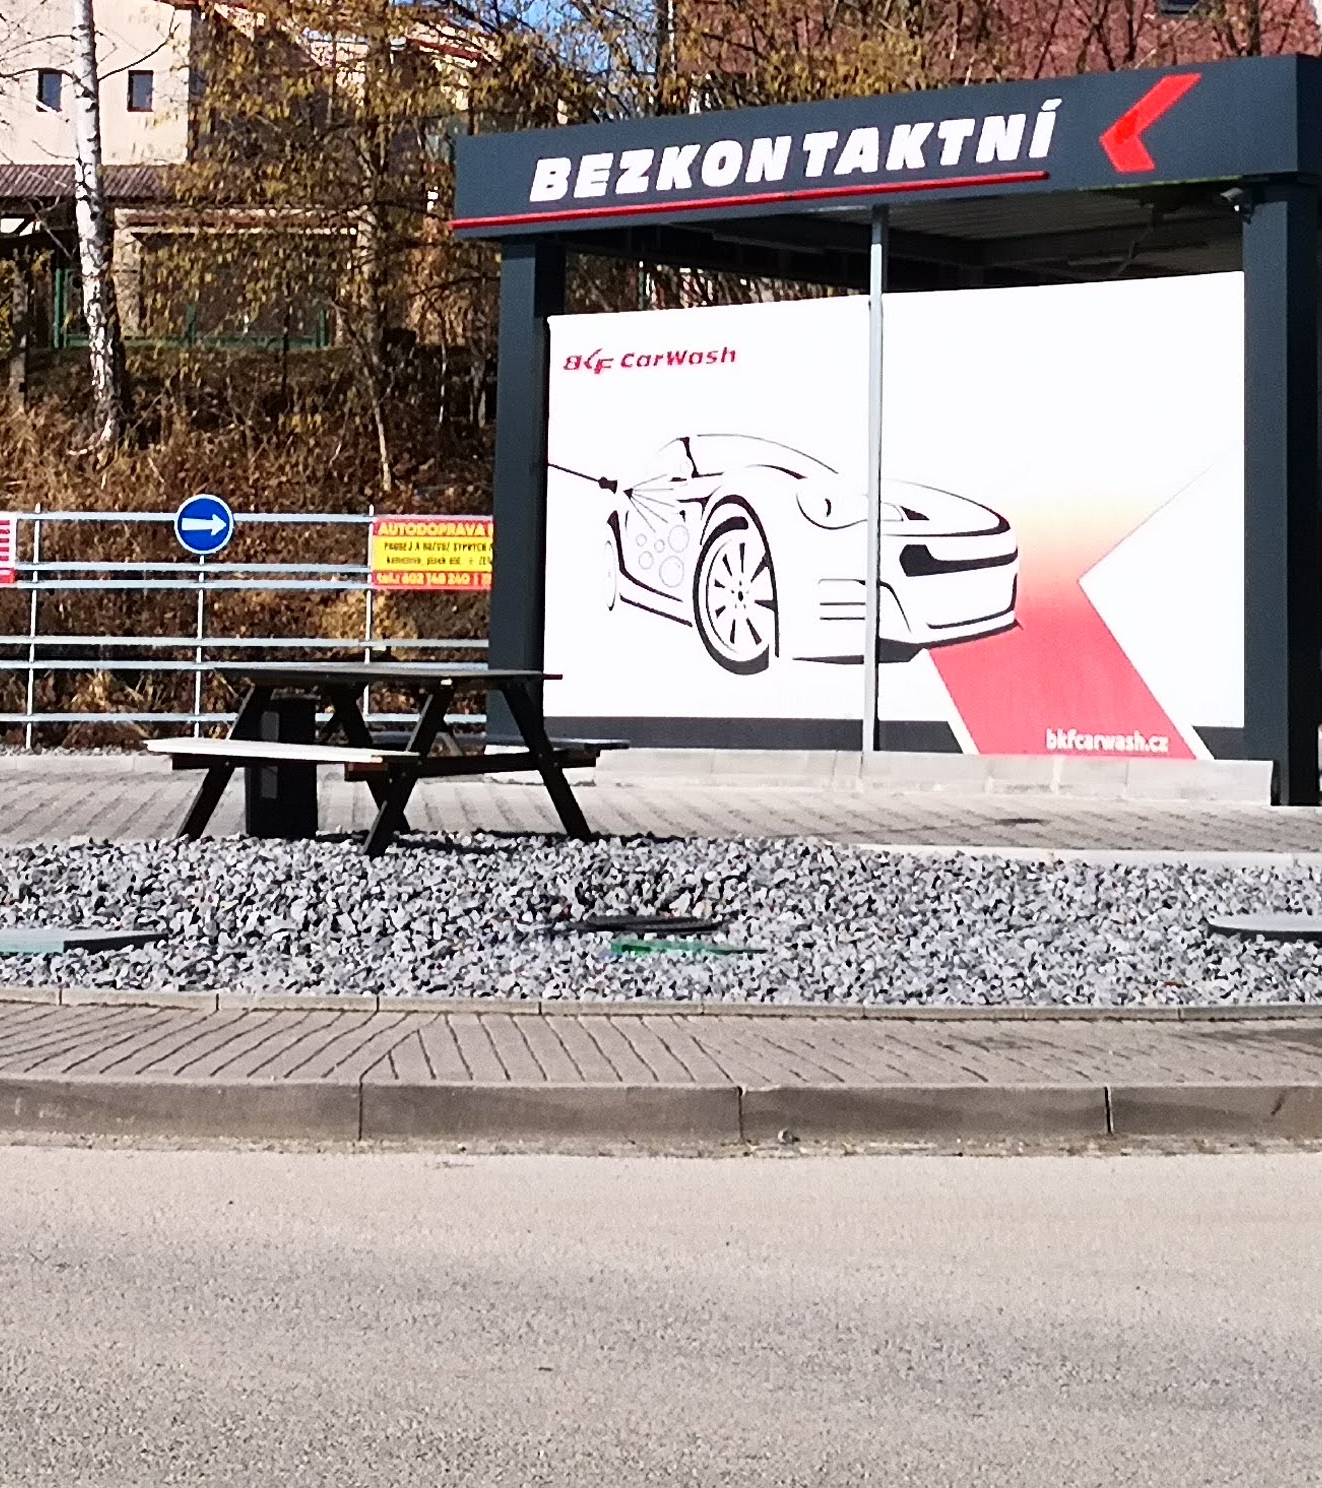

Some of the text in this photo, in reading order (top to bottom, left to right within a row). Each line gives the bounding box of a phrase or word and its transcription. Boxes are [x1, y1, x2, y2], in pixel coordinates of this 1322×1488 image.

[529, 98, 1063, 202] BEZKONTAKTNÍ
[563, 347, 736, 374] BKF CarWash
[378, 522, 485, 536] AUTODOPRAVA
[1045, 728, 1169, 752] bkfcarwash.cz
